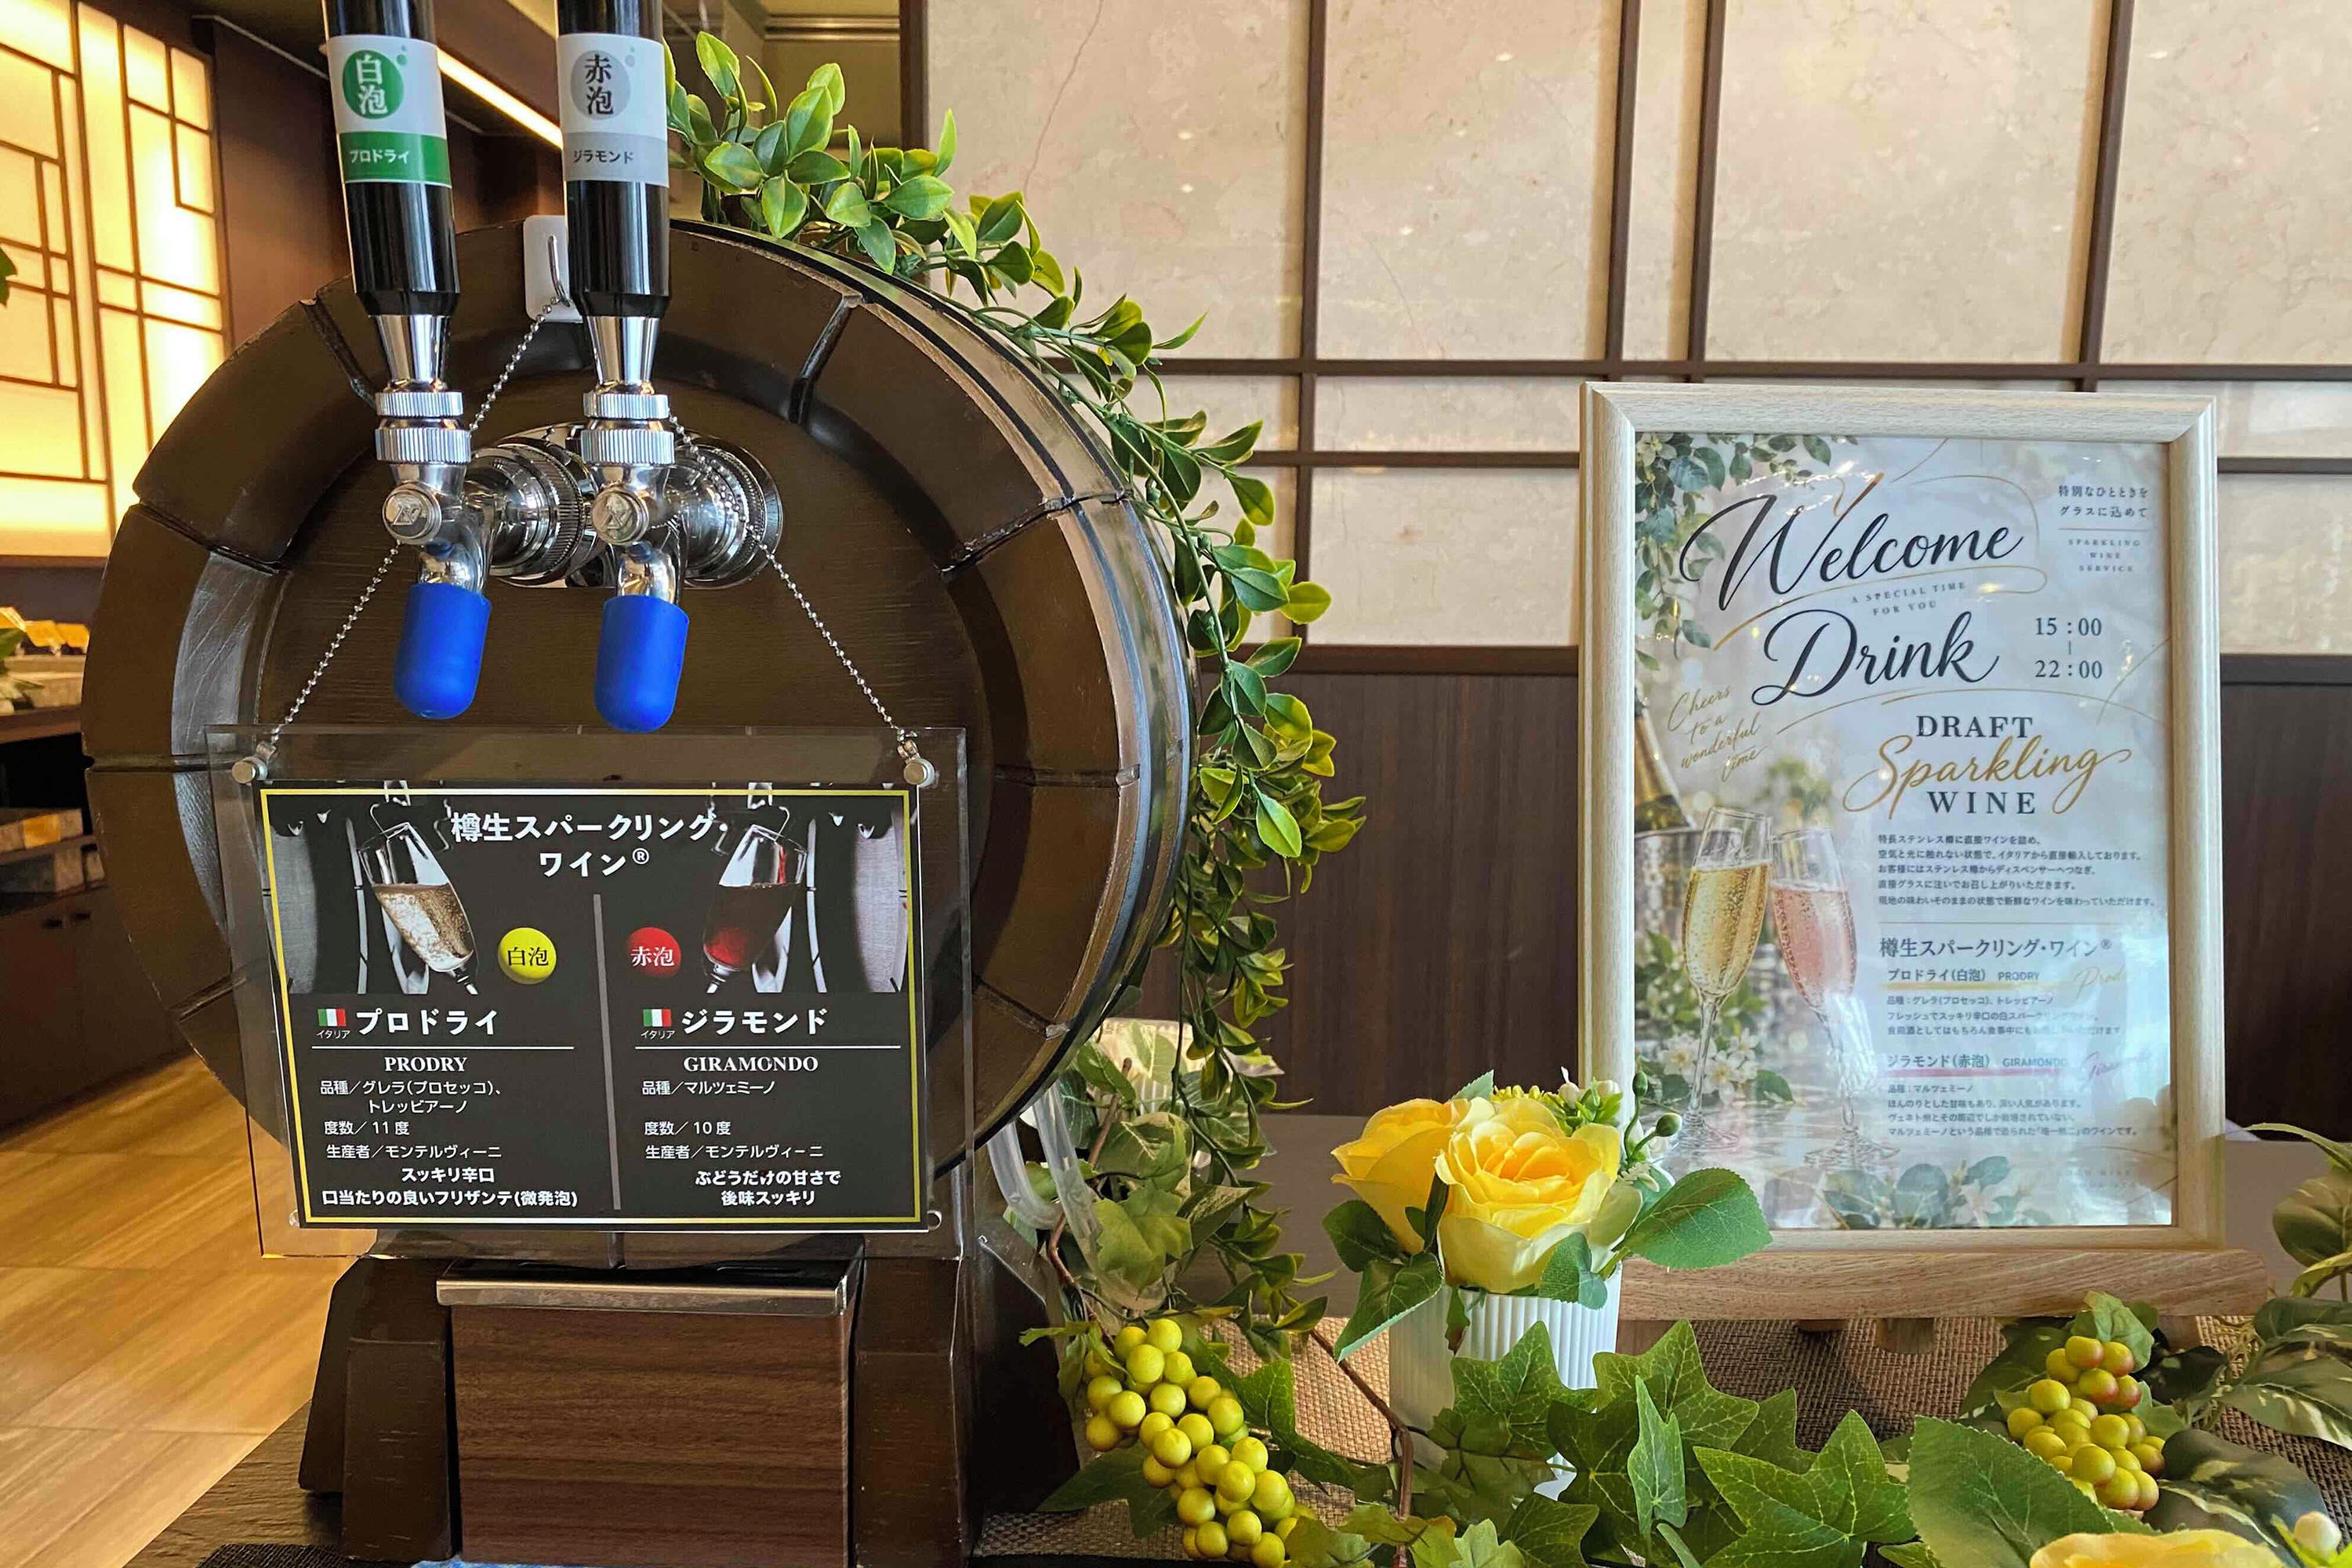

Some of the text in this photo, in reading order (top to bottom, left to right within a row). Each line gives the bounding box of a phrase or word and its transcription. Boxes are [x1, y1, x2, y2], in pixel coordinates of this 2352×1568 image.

[355, 54, 389, 115] 白泡
[584, 53, 615, 115] 赤泡
[350, 149, 410, 165] プロドライ
[573, 149, 634, 165] ジラモンド
[2059, 485, 2148, 498] 特別なひとときを
[2060, 506, 2148, 517] グラスに込めて
[1679, 472, 2024, 611] Welcome
[1866, 587, 1926, 601] SPECIAL
[1932, 582, 1966, 593] TIME
[1873, 601, 1937, 616] FOR YOU
[1751, 608, 1999, 706] Drink
[1668, 685, 1731, 731] Cheers
[1915, 715, 2033, 739] DRAFT
[1681, 712, 1761, 768] wonderful
[1842, 735, 2132, 820] Sparkling
[1926, 791, 2036, 815] WINE
[507, 946, 549, 967] 白泡
[630, 946, 674, 967] 赤泡
[1998, 971, 2040, 981] PRODRY
[357, 1007, 499, 1036] プロドライ
[681, 1007, 829, 1036] ジラモンド
[316, 1029, 350, 1040] イタリア
[640, 1029, 675, 1040] イタリア
[384, 1056, 468, 1073] PRODRY
[684, 1056, 818, 1073] GIRAMONDO
[369, 1100, 468, 1114] トレッビアーノ
[401, 1167, 495, 1183] スッキリ辛口
[695, 1170, 841, 1186] ぶどうだけの甘さで
[321, 1190, 579, 1207] 口当たりの良いフリザンテ(微発泡)
[720, 1190, 815, 1207] 後味スッキリ
